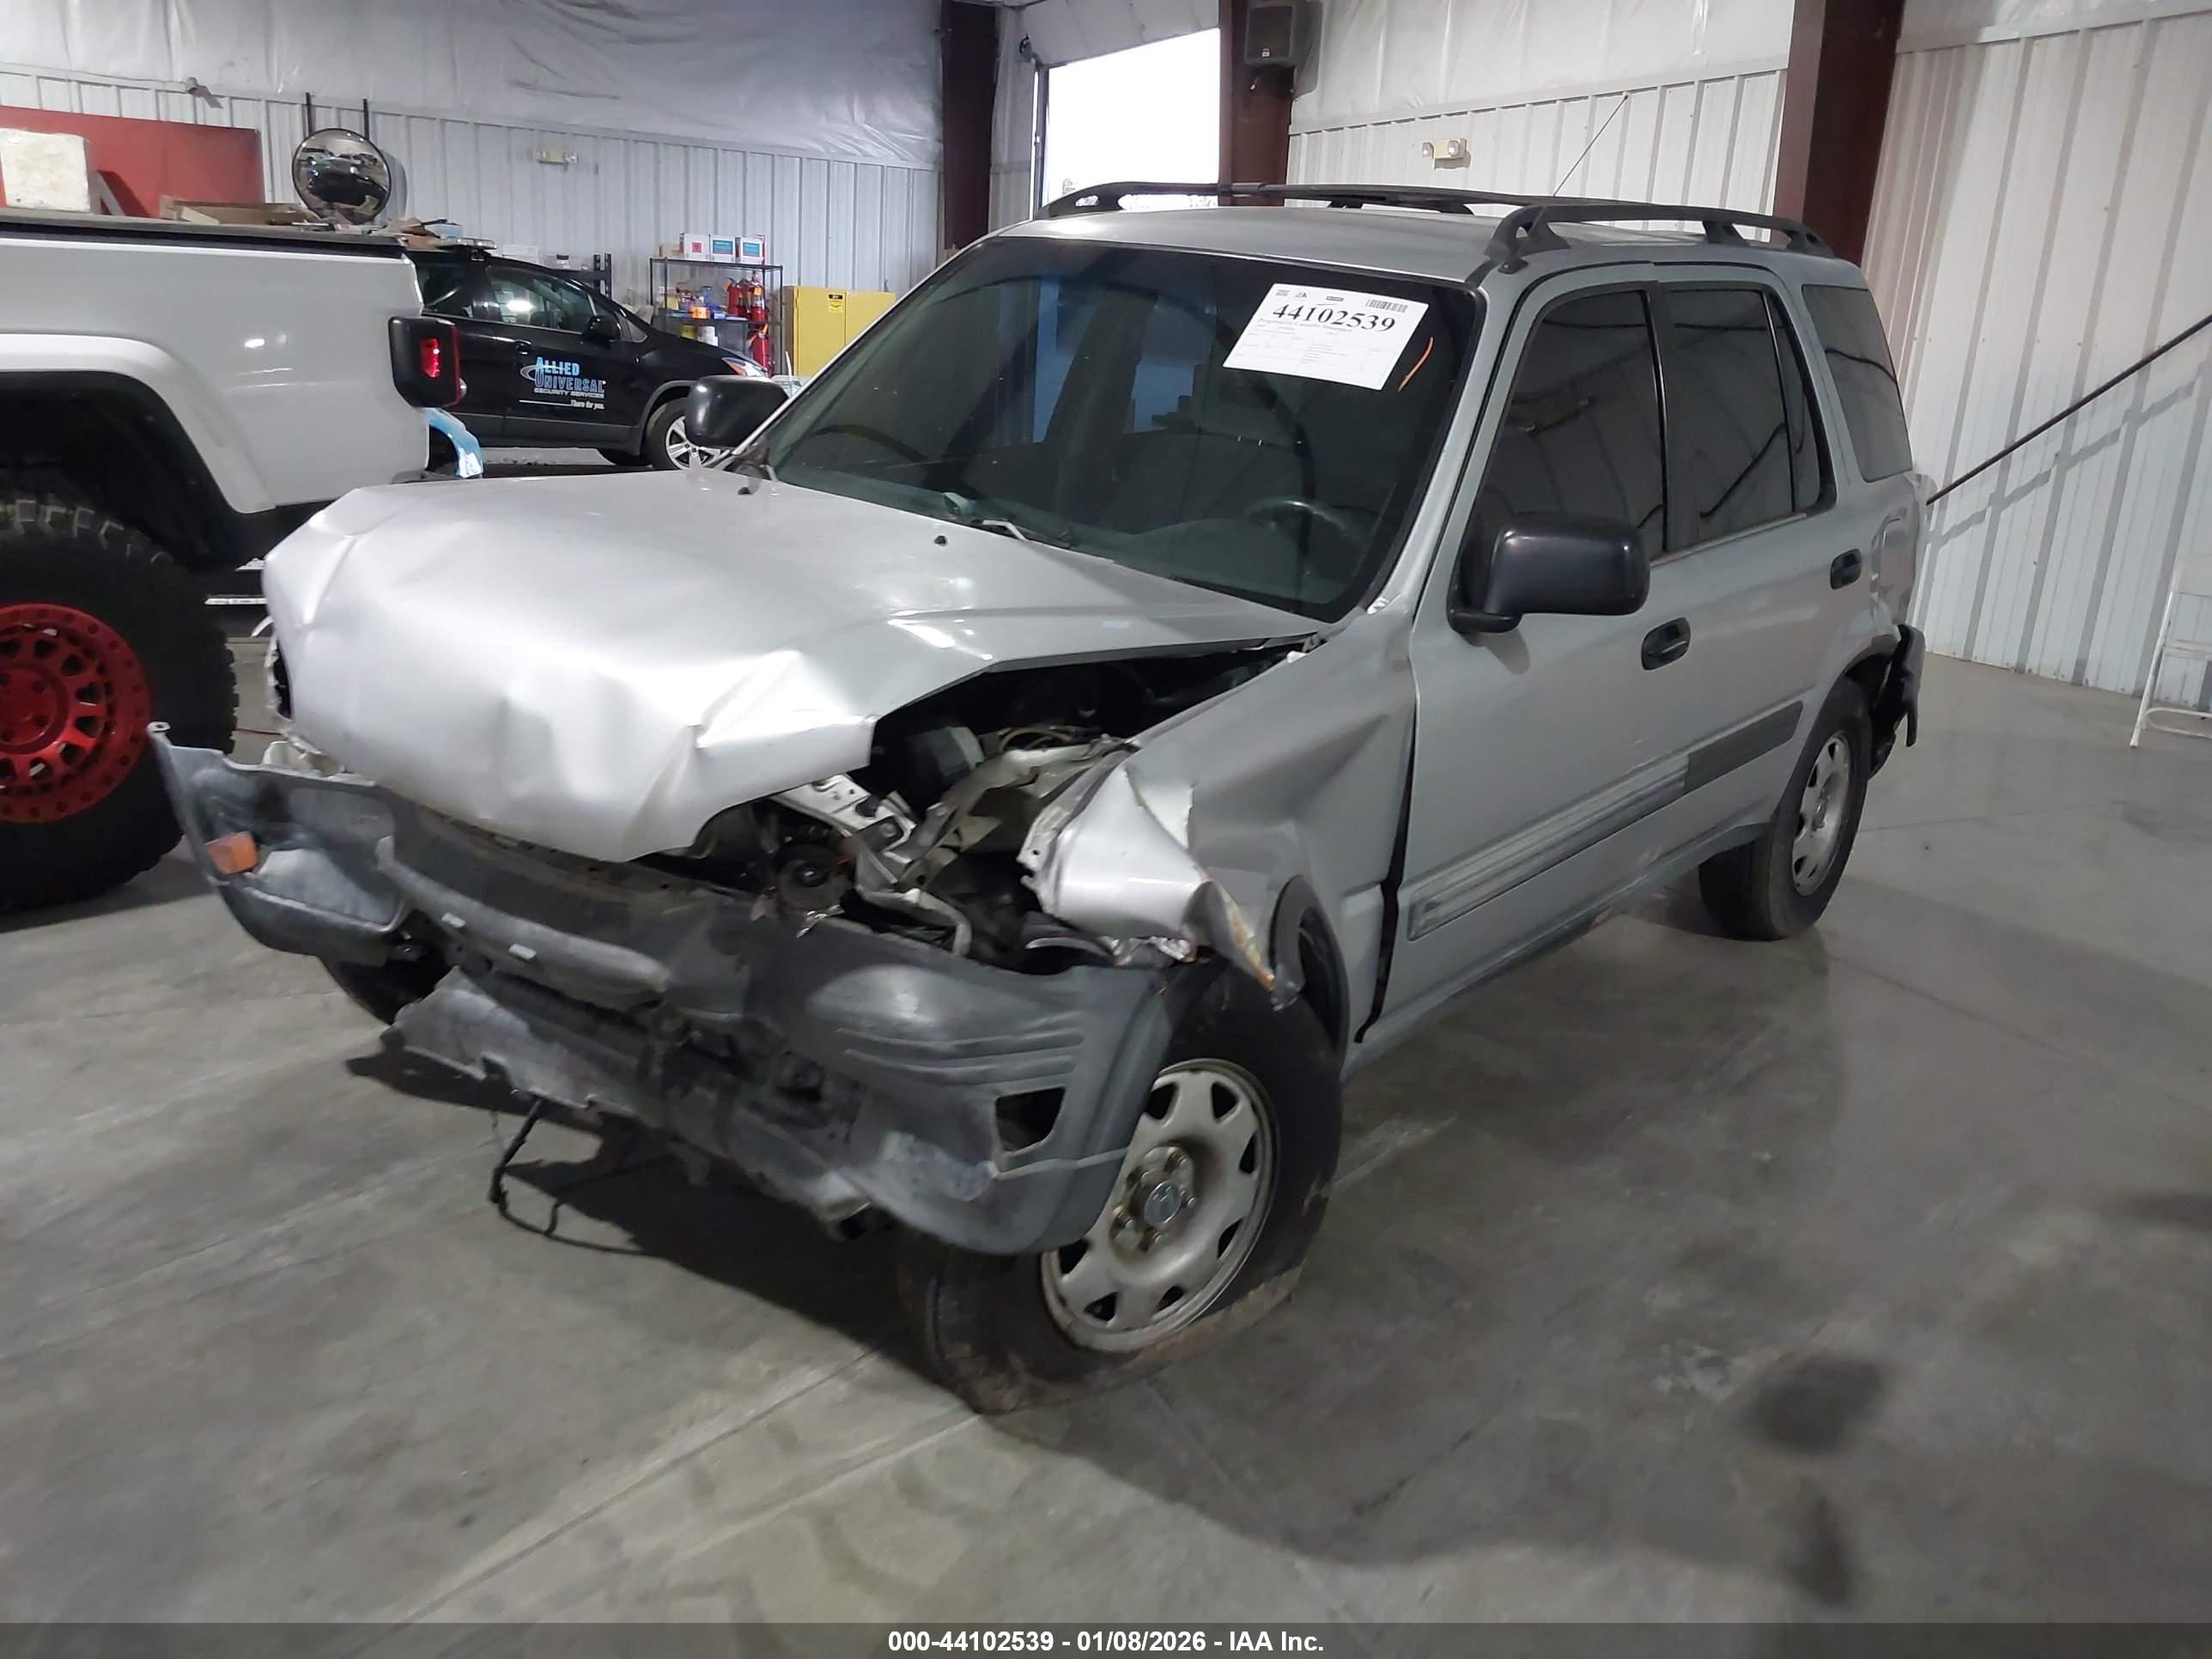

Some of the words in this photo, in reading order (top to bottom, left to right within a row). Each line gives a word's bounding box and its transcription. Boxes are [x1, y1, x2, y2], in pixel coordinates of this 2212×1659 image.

[1273, 303, 1396, 332] 44102539
[535, 356, 580, 376] ALLIED
[533, 387, 569, 396] SECURITY
[534, 369, 605, 393] UNIVERSAL
